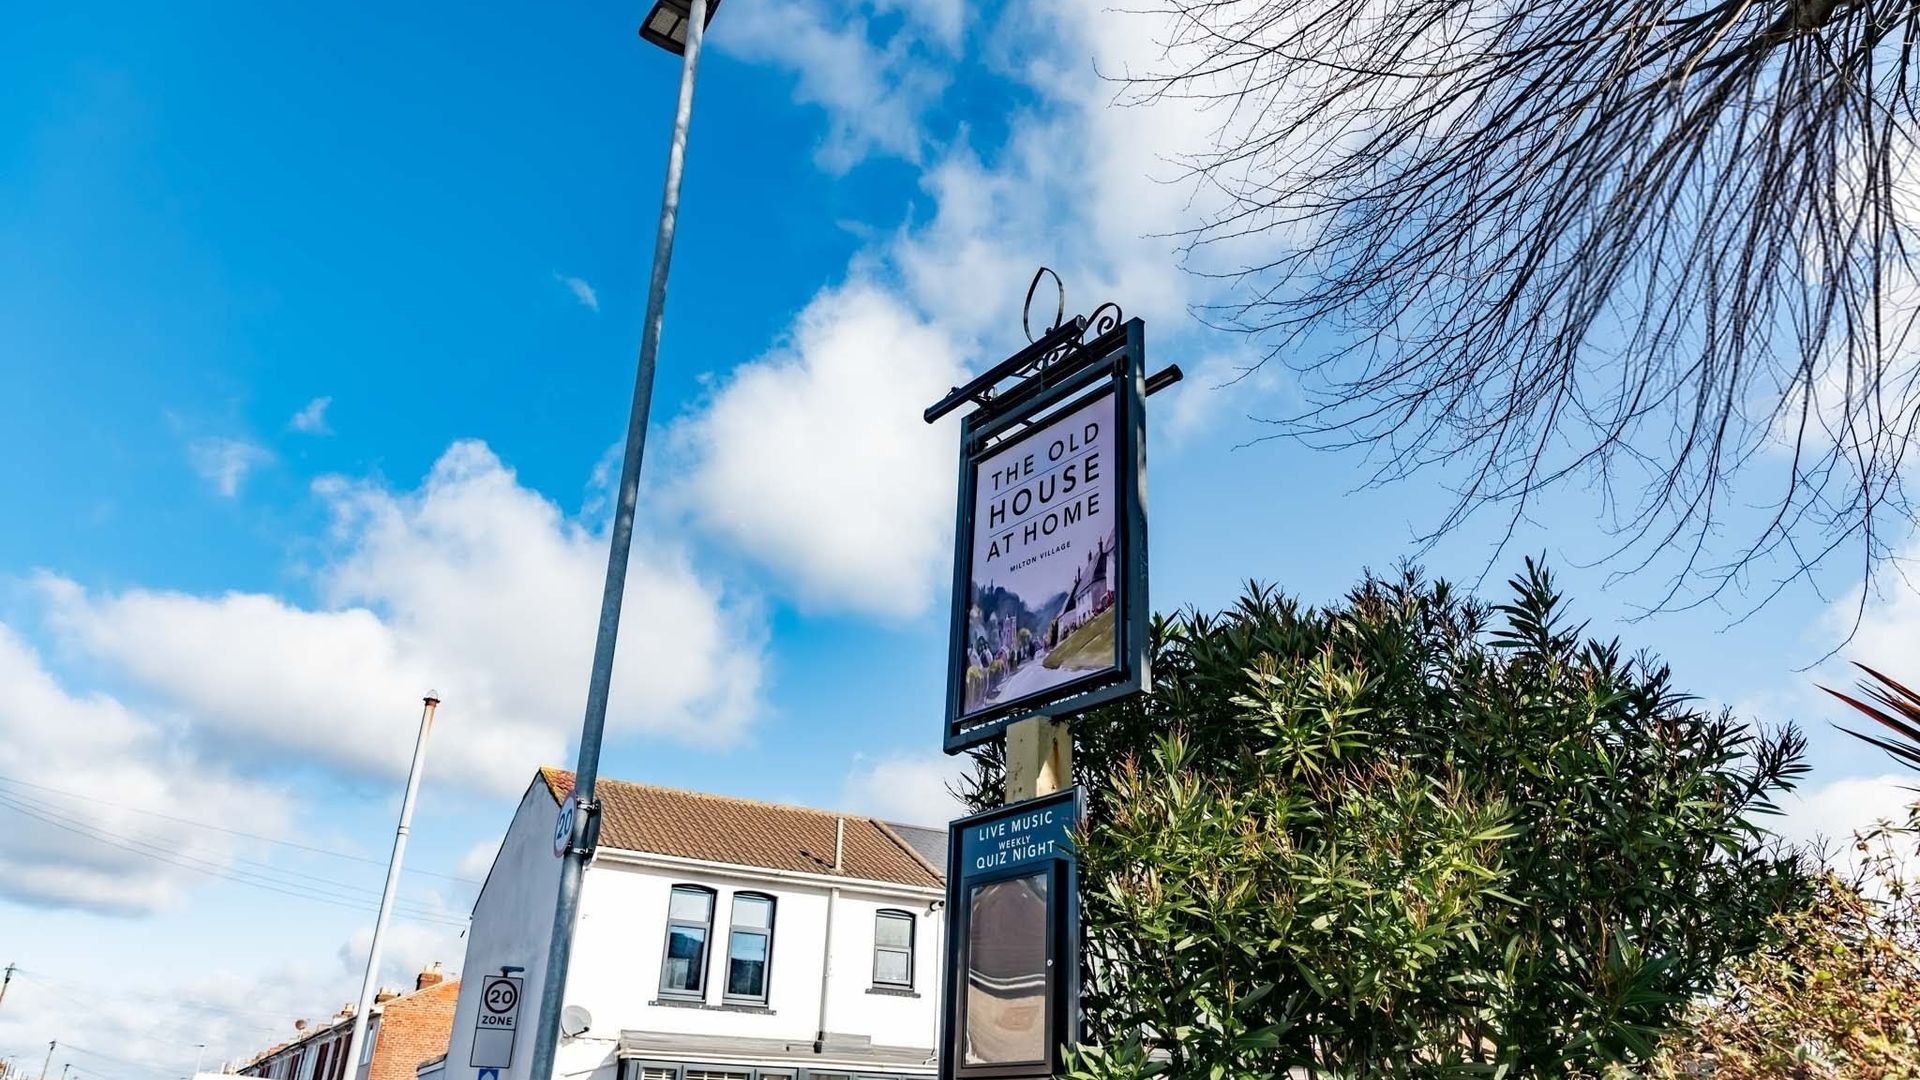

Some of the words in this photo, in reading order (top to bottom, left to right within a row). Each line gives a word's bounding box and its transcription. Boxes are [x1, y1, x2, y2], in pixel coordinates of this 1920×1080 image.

[991, 454, 1034, 490] THE
[1048, 422, 1099, 462] OLD
[989, 452, 1100, 529] HOUSE
[986, 533, 1014, 562] AT
[1024, 492, 1100, 545] HOME
[1009, 556, 1037, 572] MILTON
[1040, 541, 1071, 559] VILLAGE
[557, 811, 573, 838] 20
[979, 823, 1005, 841] LIVE
[1011, 811, 1053, 833] MUSIC
[976, 851, 1007, 869] QUIZ
[1012, 840, 1055, 862] NIGHT
[998, 835, 1031, 850] WEEKLY
[489, 989, 513, 1004] 20
[481, 1015, 513, 1026] ZONE
